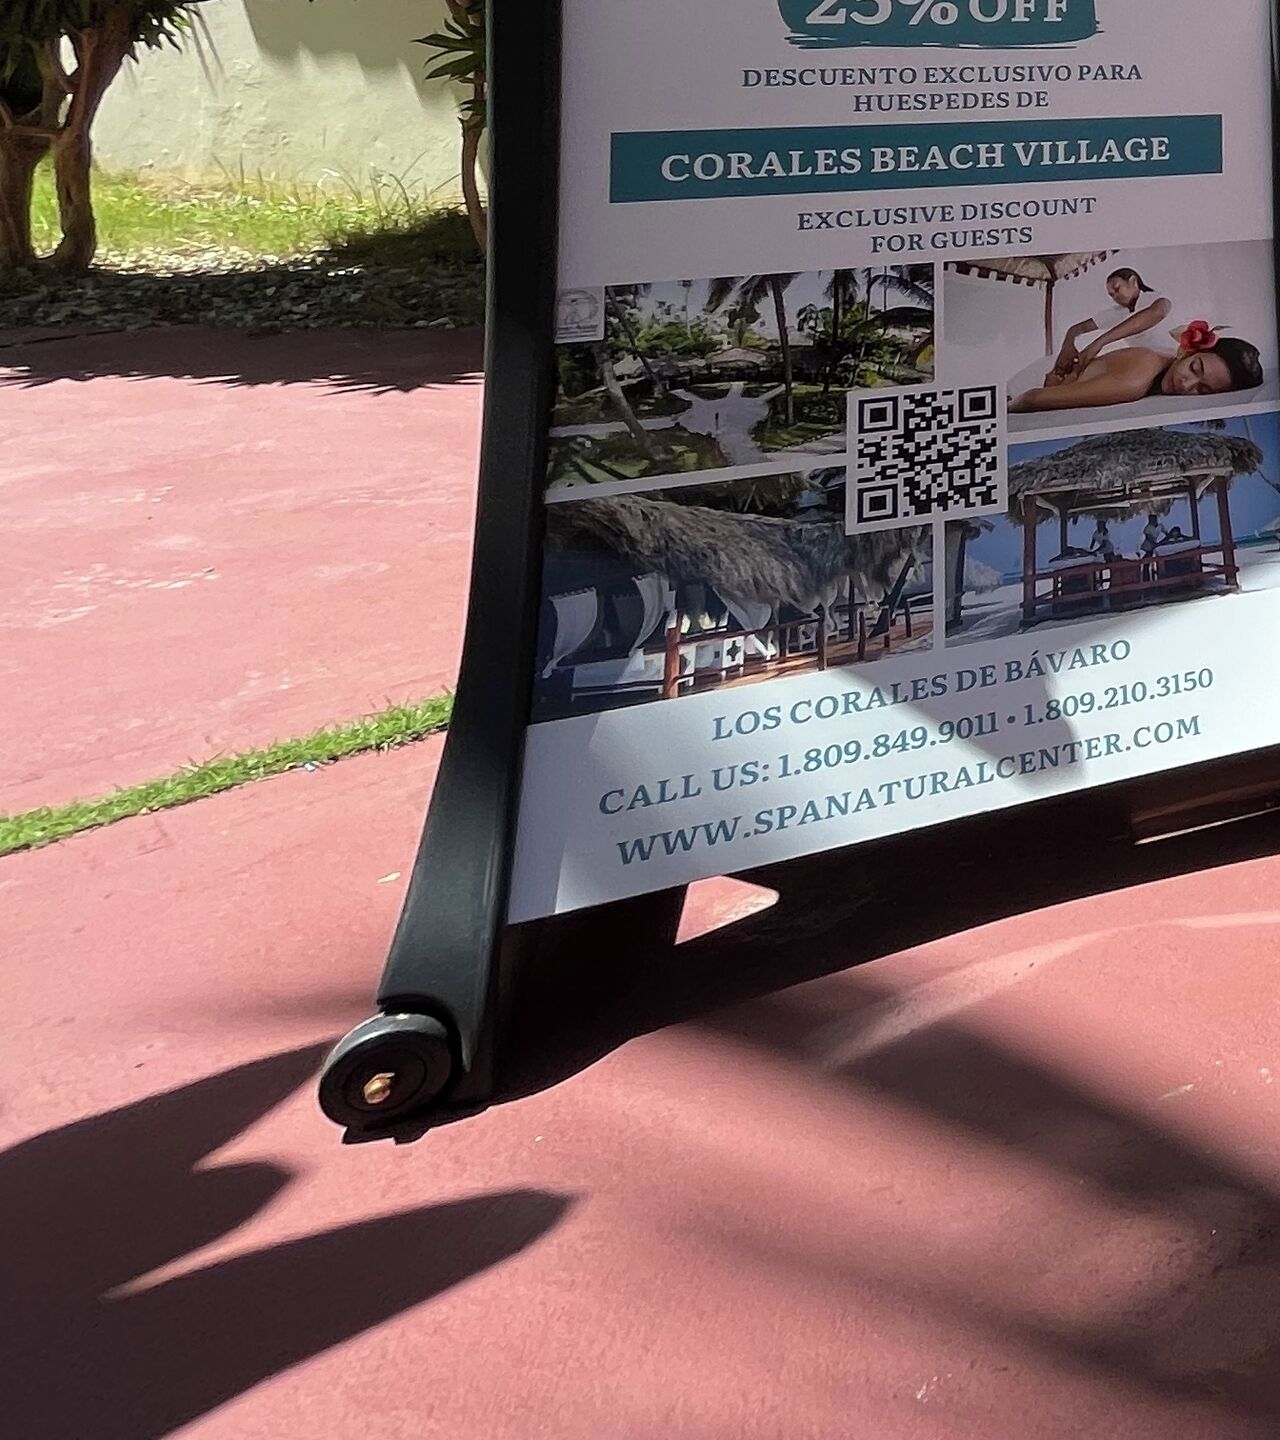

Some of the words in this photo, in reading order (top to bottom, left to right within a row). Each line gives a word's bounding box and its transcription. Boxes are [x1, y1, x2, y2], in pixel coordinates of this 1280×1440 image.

[742, 66, 918, 88] DESCUENTO
[923, 64, 1072, 85] EXCLUSIVO
[1077, 63, 1143, 83] PARA
[853, 91, 1010, 113] HUESPEDES
[1016, 90, 1050, 109] DE
[660, 147, 863, 183] CORALES
[870, 142, 1004, 175] BEACH
[1012, 136, 1171, 167] VILLAGE
[797, 205, 955, 231] EXCLUSIVE
[960, 197, 1098, 222] DISCOUNT
[870, 232, 925, 255] FOR
[930, 227, 1033, 251] GUESTS
[712, 705, 782, 741] LOS
[790, 673, 948, 725] CORALES
[956, 664, 997, 692] DE
[1005, 639, 1131, 683] BÁVARO
[600, 774, 702, 815] CALL
[712, 761, 770, 792] US:
[778, 711, 999, 779] 1.809.849.9011
[1024, 668, 1213, 726] 1.809.210.3150
[617, 714, 1201, 865] WWW.SPANATURALCENTER.COM
